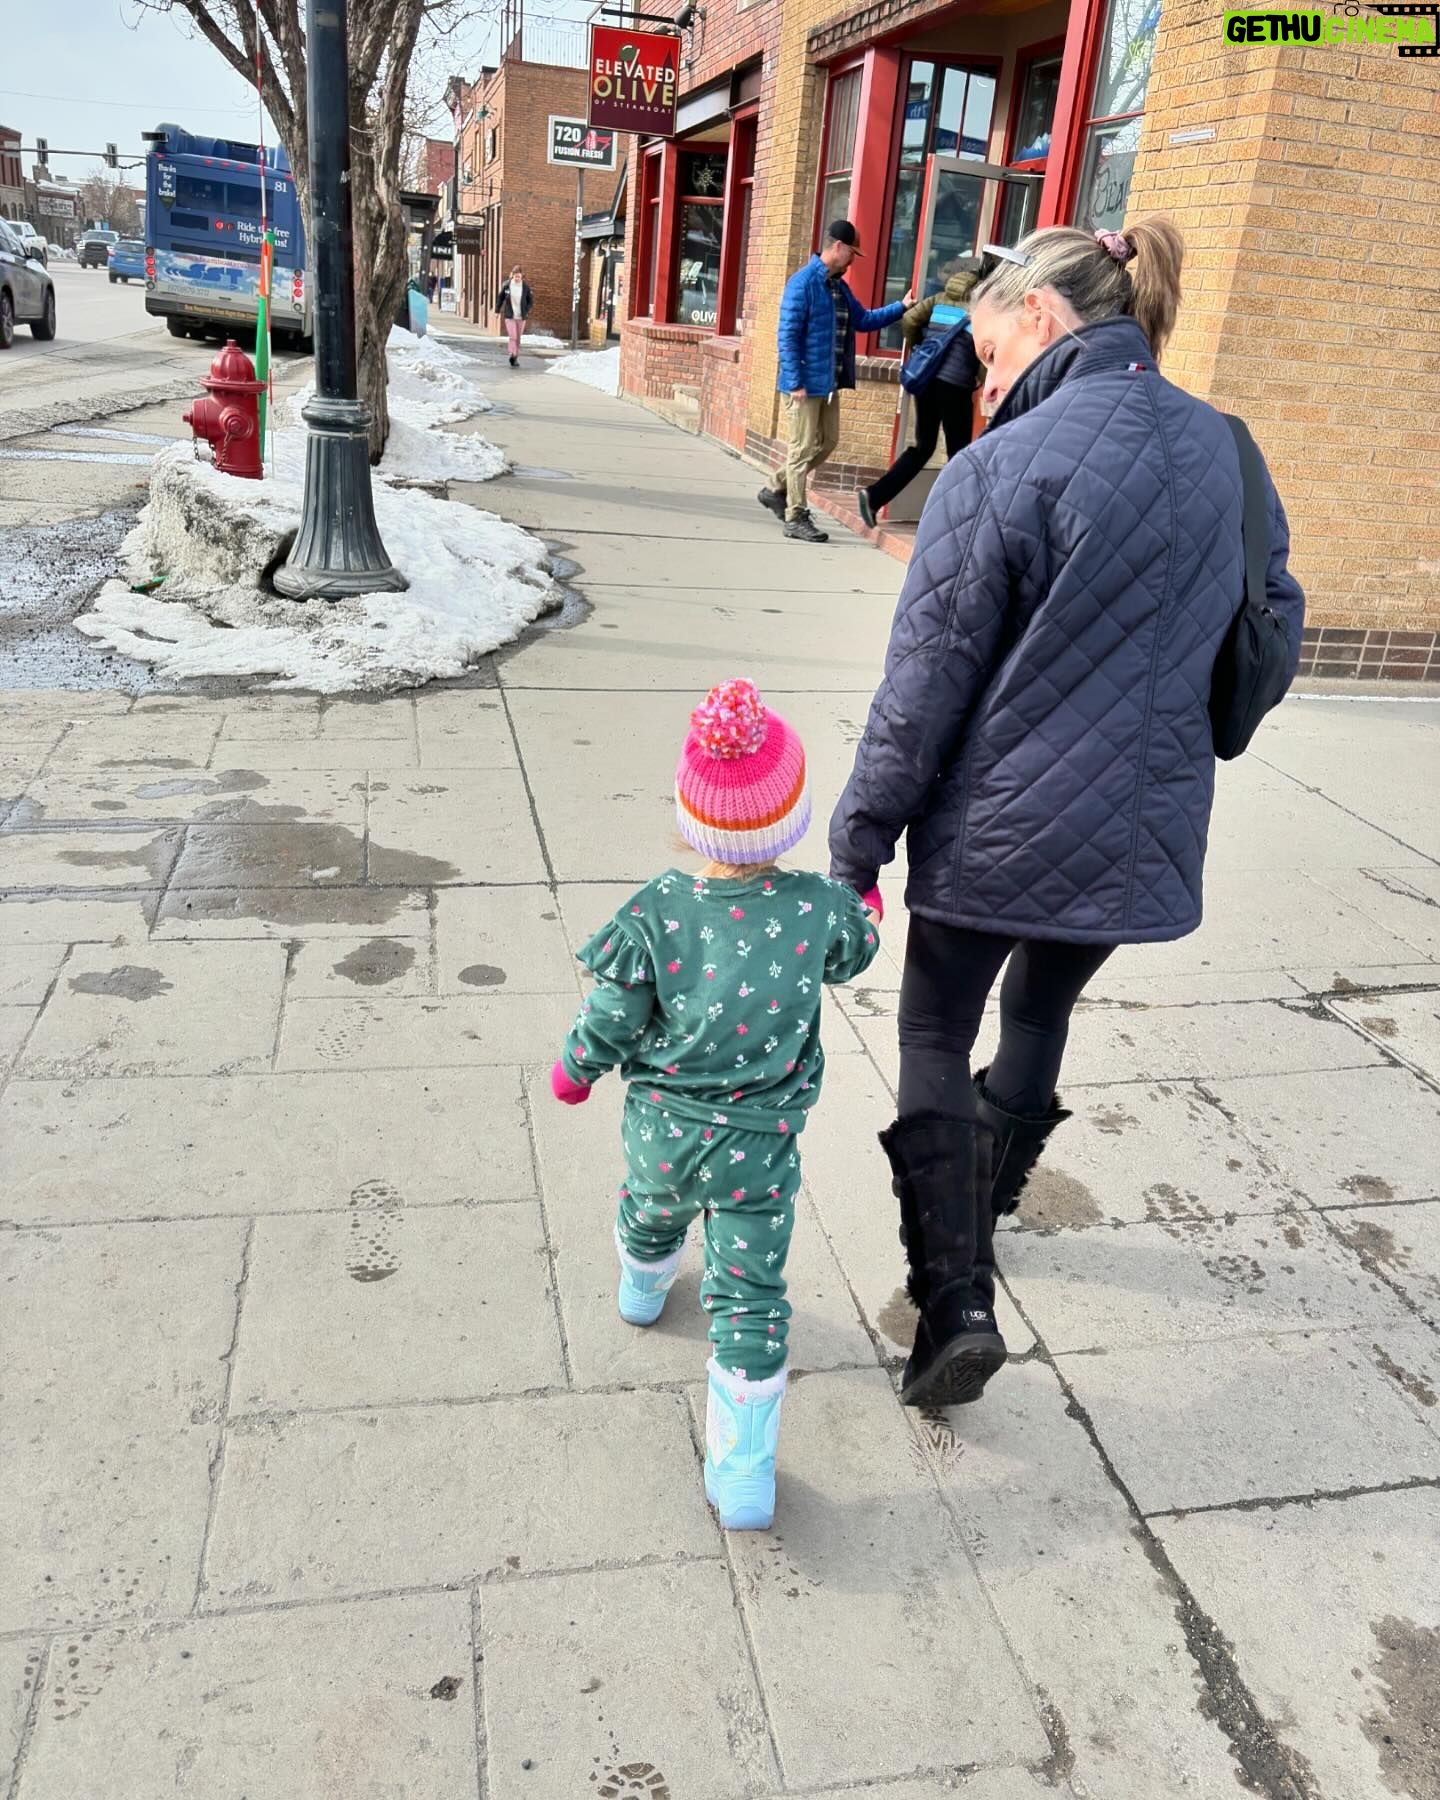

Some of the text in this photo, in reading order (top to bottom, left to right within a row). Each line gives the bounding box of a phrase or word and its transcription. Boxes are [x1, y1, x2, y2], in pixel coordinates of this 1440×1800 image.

[595, 49, 676, 83] ELEVATED
[594, 75, 674, 106] OLIVE
[594, 98, 672, 114] OF STEAMBOAT
[555, 126, 582, 142] 720
[554, 145, 604, 160] FUSION FRESH
[275, 181, 287, 193] 81
[237, 221, 257, 232] Ride
[274, 226, 290, 238] free
[274, 239, 288, 248] us!
